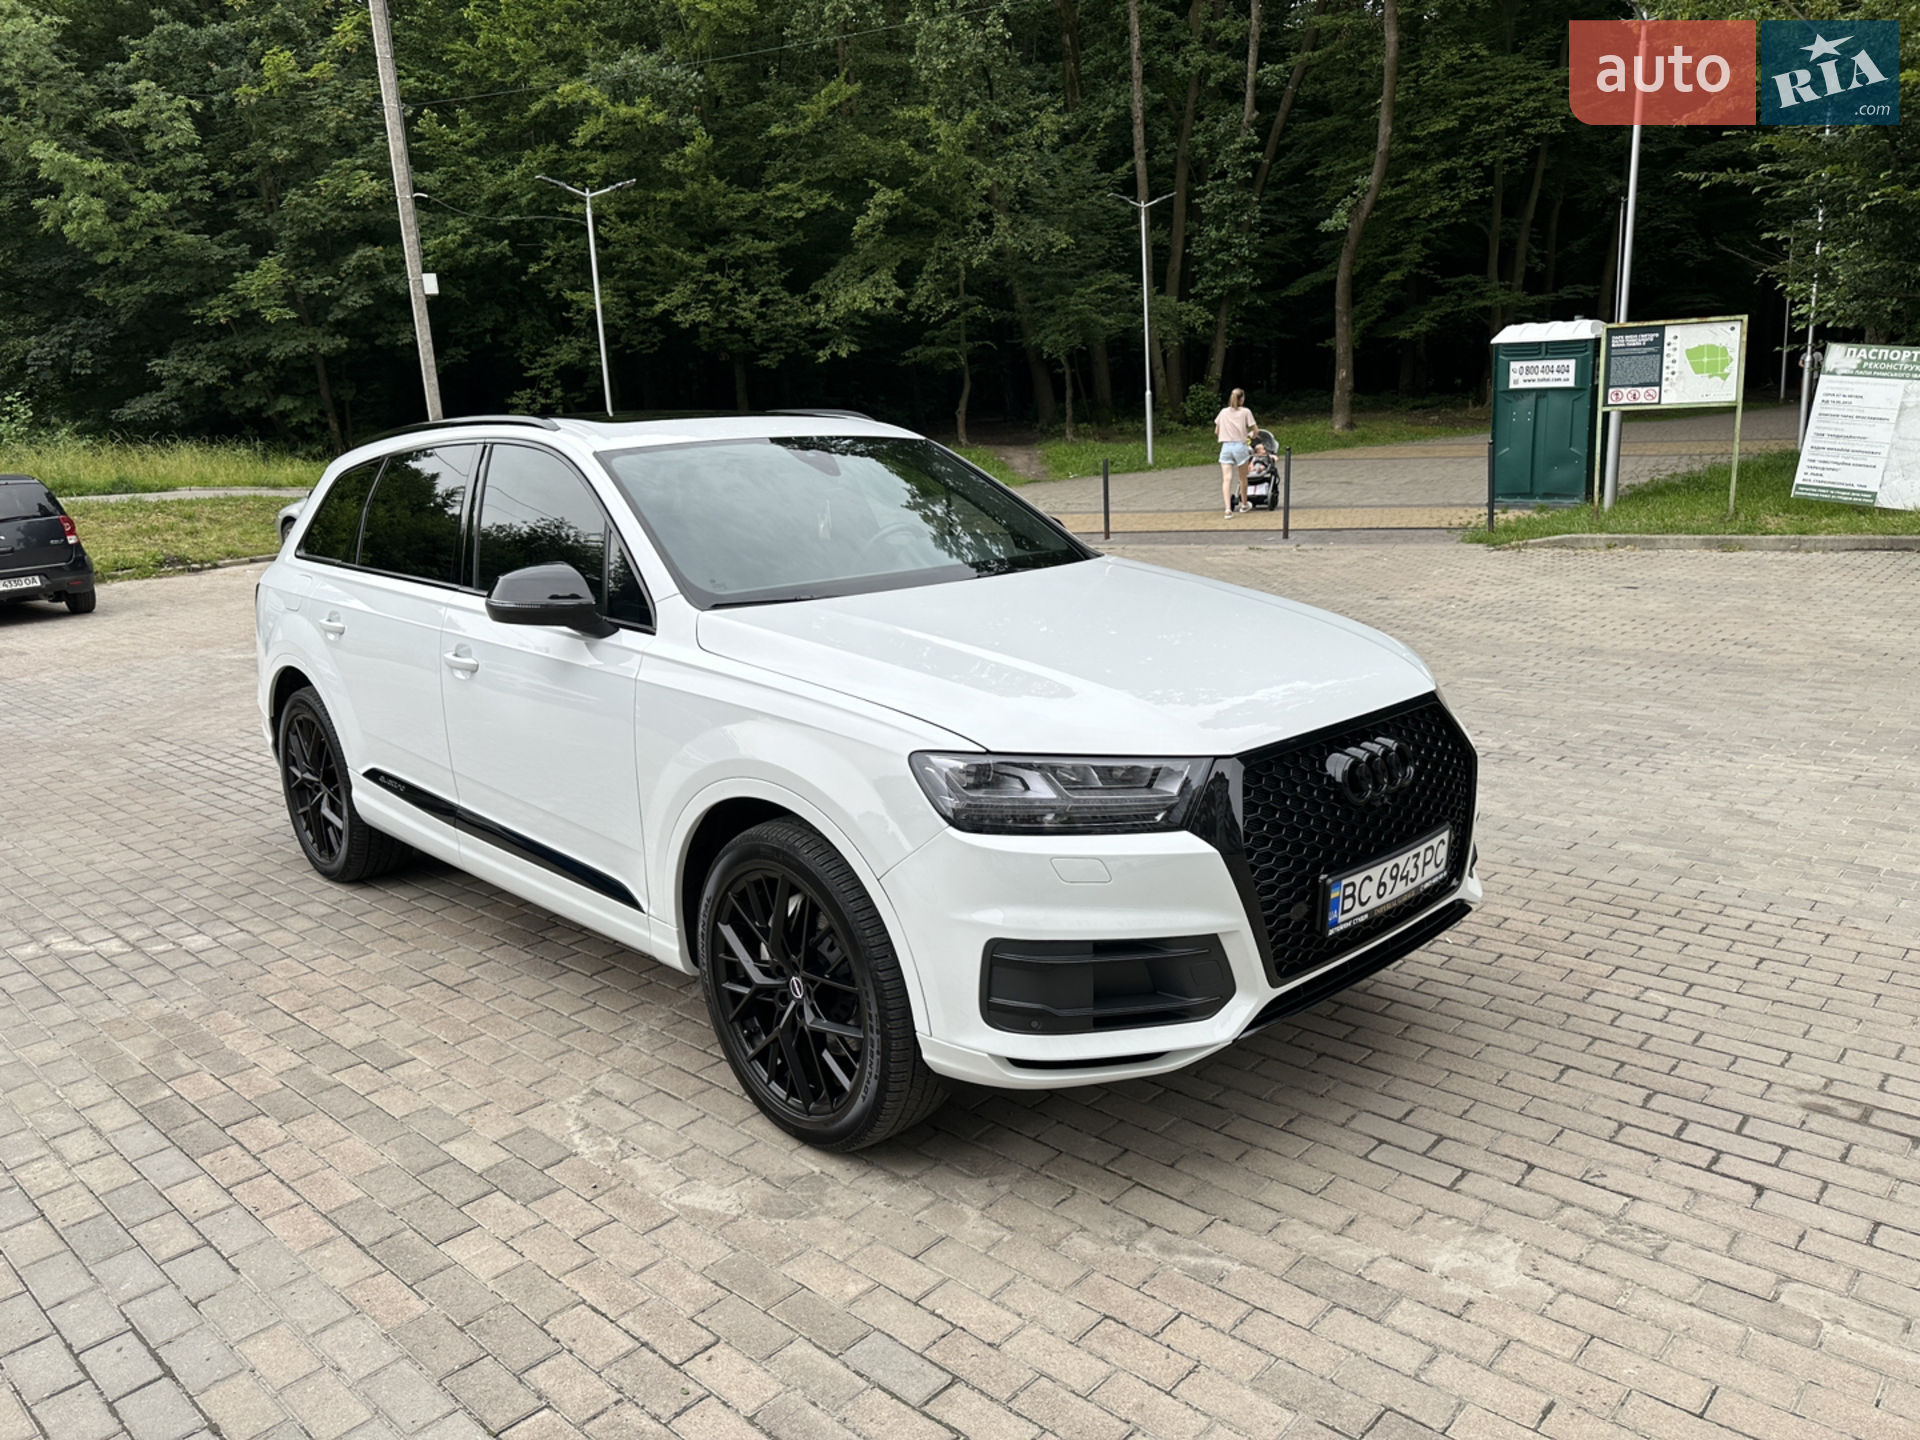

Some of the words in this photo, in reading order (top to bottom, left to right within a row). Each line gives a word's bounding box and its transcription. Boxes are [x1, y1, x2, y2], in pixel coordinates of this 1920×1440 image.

[1845, 347, 1920, 362] ПАСПОРТ
[1518, 365, 1524, 376] 0
[1525, 365, 1539, 375] 800
[1540, 364, 1554, 375] 404
[1555, 363, 1570, 374] 404
[2, 578, 23, 589] 4330
[24, 576, 38, 586] OA
[1340, 874, 1373, 916] BC
[1375, 850, 1421, 899] 6943
[1420, 838, 1446, 878] PC
